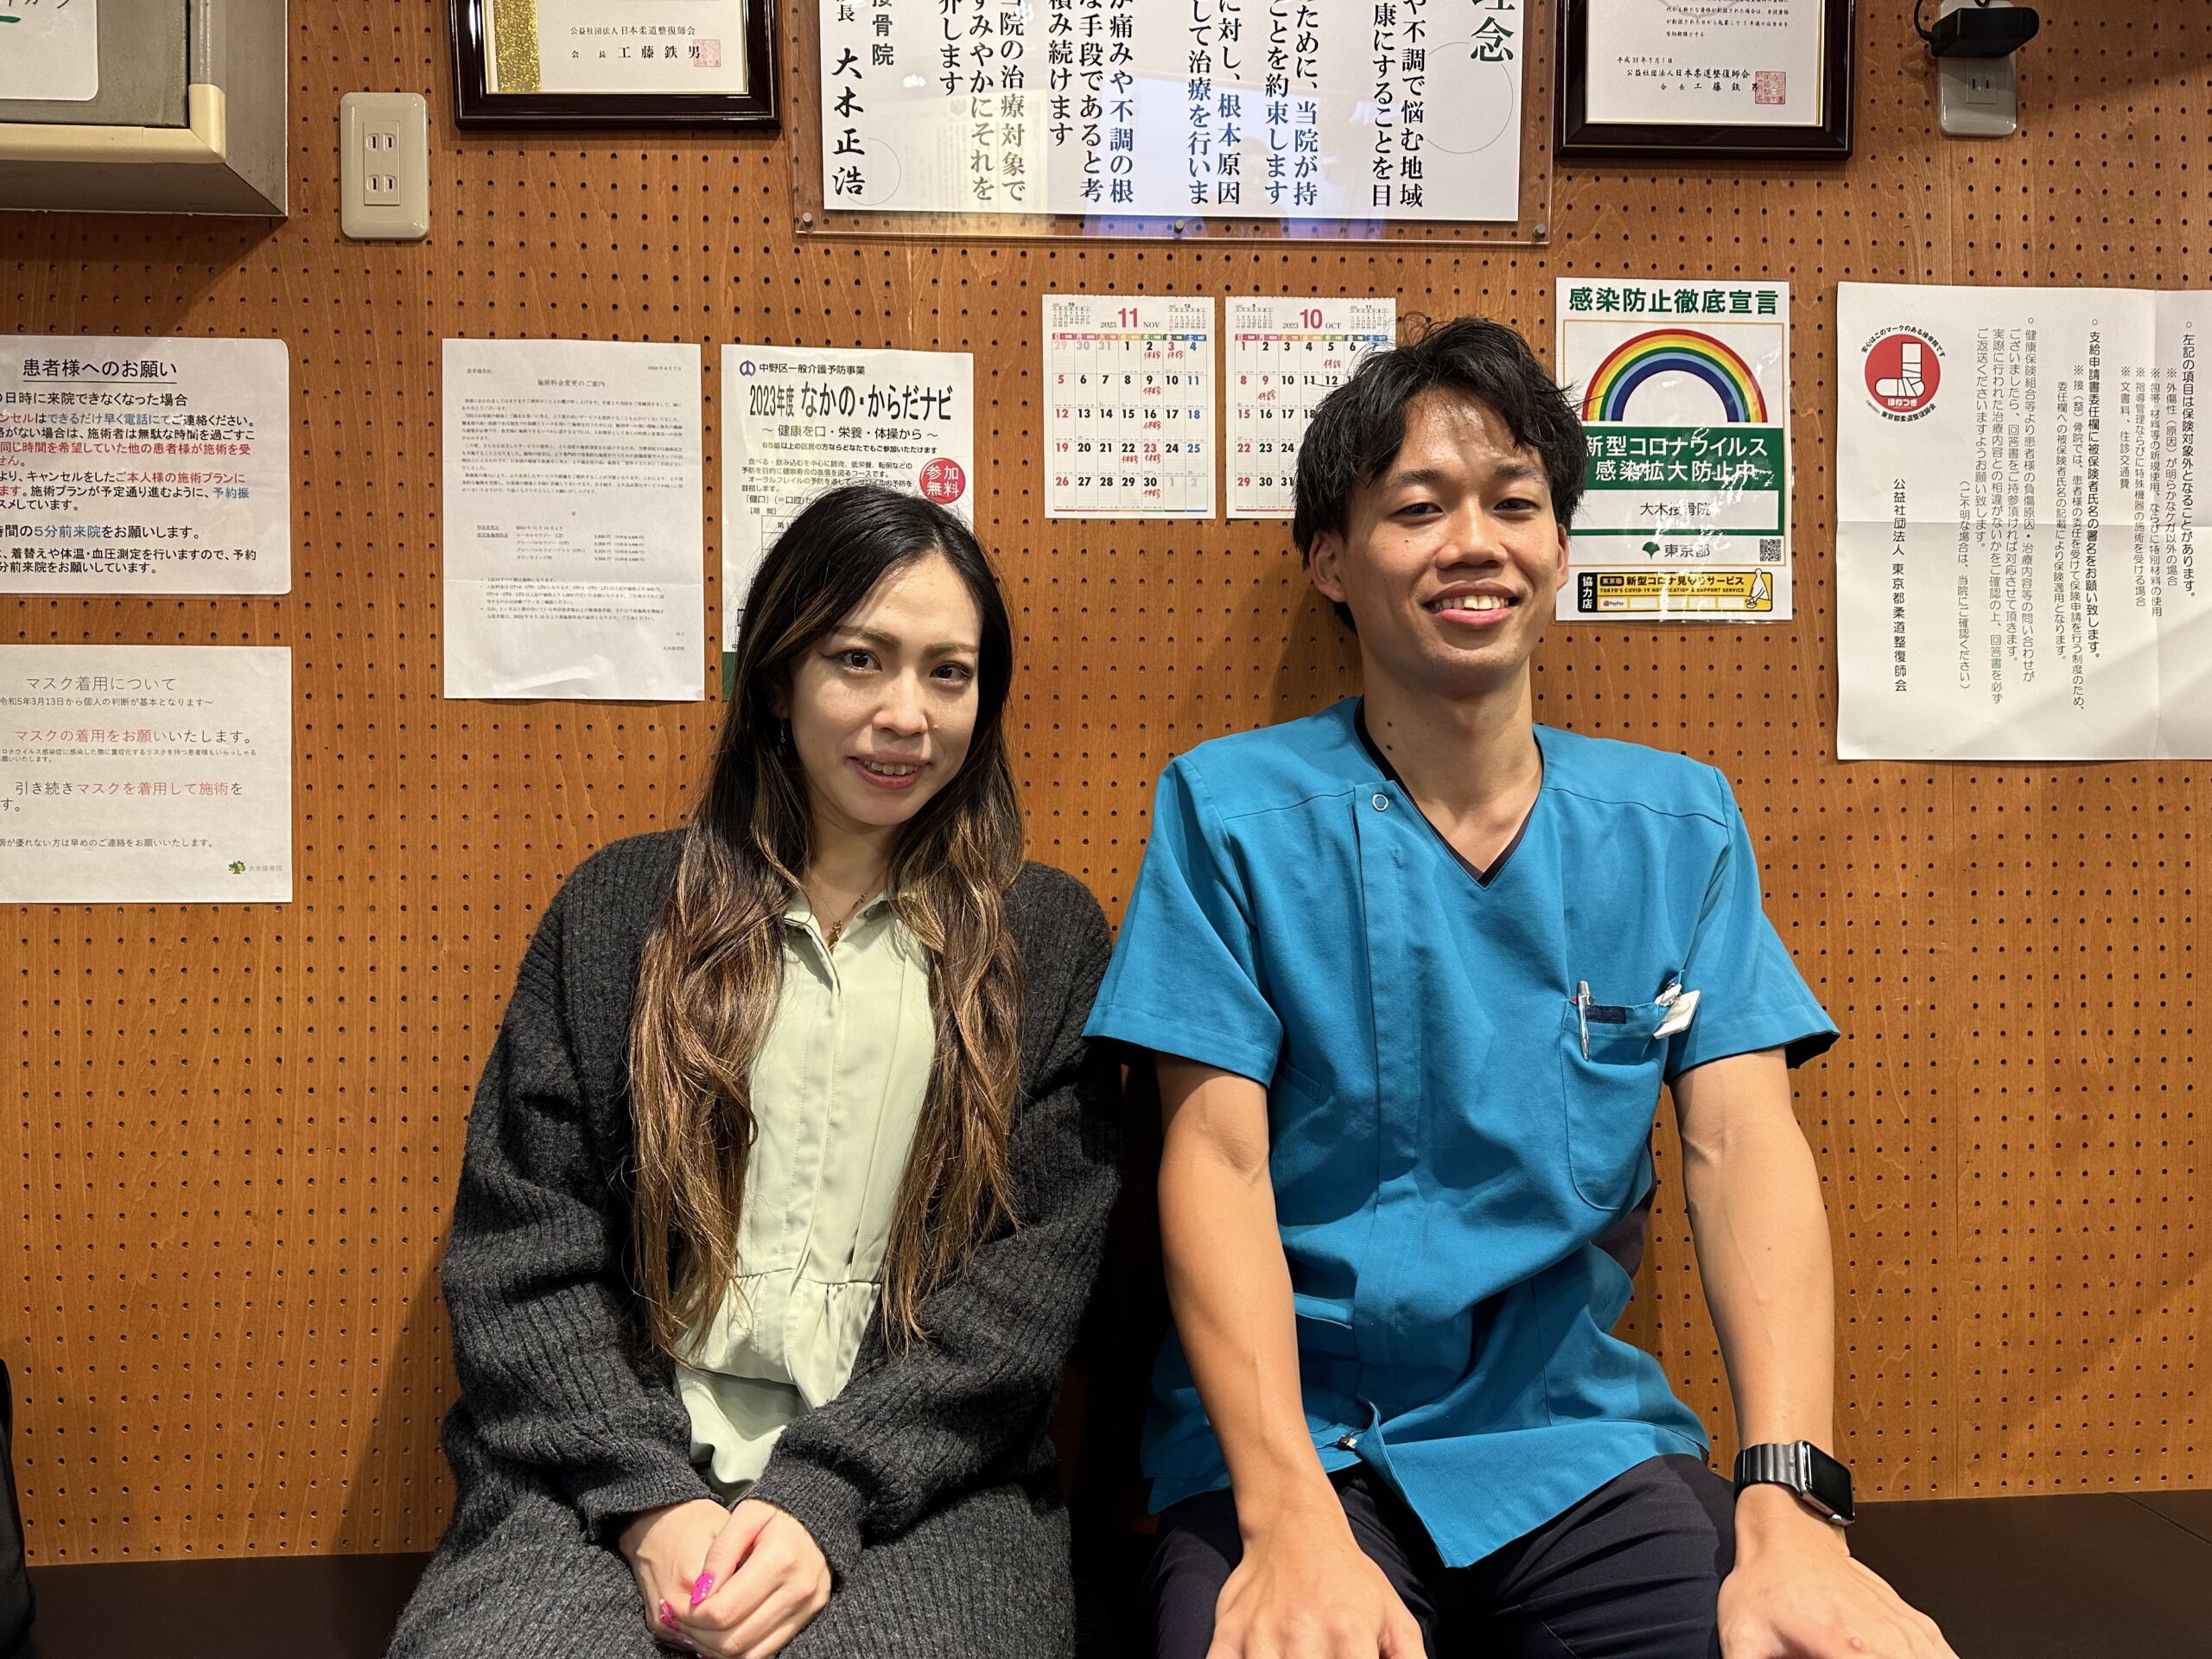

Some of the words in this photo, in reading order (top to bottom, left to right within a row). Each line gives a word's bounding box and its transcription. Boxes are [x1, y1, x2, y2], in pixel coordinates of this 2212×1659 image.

[570, 26, 696, 35] 公益社団法人日本柔道整復師会
[872, 0, 894, 66] 骨院
[618, 46, 701, 60] 工藤鉄男
[1626, 67, 1751, 79] 公益社団法人日本柔道整復師会
[1694, 81, 1759, 92] 工藤鉄男
[1000, 0, 1026, 202] 院の治療対象で
[1188, 0, 1212, 205] して治療を行いま
[1264, 0, 1289, 206] ことを約束します
[1294, 0, 1319, 207] ために、当院が持
[1372, 2, 1397, 207] 康にすることを目
[831, 48, 866, 197] 大木正浩
[1568, 287, 1778, 315] 感染防止徹底宣言
[1118, 308, 1137, 327] 11
[1300, 309, 1322, 328] 10
[1125, 341, 1129, 350] 1
[1147, 341, 1153, 350] 2
[1168, 341, 1174, 351] 3
[1190, 342, 1196, 351] 4
[1242, 341, 1245, 351] 1
[1262, 341, 1268, 351] 2
[1284, 342, 1290, 351] 3
[1306, 342, 1313, 351] 4
[1328, 342, 1333, 351] 5
[1350, 342, 1356, 351] 6
[22, 359, 177, 378] 患者様へのお願い
[759, 363, 866, 375] 中野区一般介護予防事業
[537, 379, 606, 388] 施術料金変更のご案内
[1058, 375, 1064, 384] 5
[1080, 375, 1086, 384] 6
[1103, 375, 1109, 384] 7
[1125, 375, 1130, 385] 8
[1147, 376, 1153, 385] 9
[1166, 376, 1178, 385] 10
[1188, 376, 1198, 385] 11
[1241, 375, 1247, 385] 8
[1262, 376, 1268, 385] 9
[1282, 376, 1294, 385] 10
[1304, 376, 1316, 385] 11
[1325, 376, 1339, 386] 12
[0, 391, 188, 406] 日時に来院できなくなった場合
[749, 384, 795, 417] 2023年度
[800, 380, 954, 422] なかの・からだナビ
[1887, 397, 1917, 407] ほねつぎ
[1056, 409, 1068, 418] 12
[1078, 409, 1090, 418] 13
[1101, 409, 1113, 418] 14
[1122, 410, 1135, 418] 15
[1145, 410, 1156, 418] 16
[1166, 410, 1179, 418] 17
[1188, 410, 1200, 419] 18
[1238, 410, 1250, 418] 15
[1261, 410, 1272, 418] 16
[1282, 410, 1294, 418] 17
[1975, 328, 1988, 548] ご返送くださいますようお願い致します。
[1, 442, 251, 456] 同じ時間を希望していた他の患者様が施術を受
[762, 442, 938, 454] 65歳以上の区民の方ならどなたでもご参加いただけます
[1057, 442, 1068, 452] 19
[1077, 443, 1090, 452] 20
[1100, 443, 1111, 452] 21
[1122, 443, 1135, 452] 22
[1144, 443, 1156, 453] 23
[1166, 443, 1179, 453] 24
[1188, 444, 1200, 453] 25
[1237, 443, 1250, 452] 22
[1260, 443, 1272, 452] 23
[1281, 443, 1294, 452] 24
[1587, 435, 1768, 457] 新型コロナウイルス
[926, 465, 959, 480] 参加
[1595, 461, 1756, 482] 感染拡大防止中
[2181, 334, 2196, 597] 左記の項目は保険対象外となることがあります。
[926, 480, 960, 497] 無料
[1056, 477, 1069, 486] 26
[1078, 477, 1091, 486] 27
[1100, 477, 1113, 486] 28
[1122, 477, 1135, 486] 29
[1144, 477, 1157, 486] 30
[1237, 477, 1250, 486] 29
[1259, 477, 1272, 486] 30
[1281, 477, 1294, 486] 31
[0, 485, 250, 499] ます。施術プランが予定通り進むように、予約振
[2005, 328, 2020, 662] ございましたら、回答書をご持参頂ければ対応させて頂きます。
[2086, 331, 2101, 658] 支給申請書委任欄に被保険者氏名の署名をお願い致します。
[1892, 478, 1906, 556] 公益社団法人
[1990, 328, 2005, 704] 実際に行われた治療内容との相違がないかをご確認の上、回答書を必ず
[0, 524, 200, 539] 間の5分前来院をお願いします。
[0, 547, 257, 562] 、着替えや体温・血圧測定を行いますので、予約
[1664, 543, 1710, 557] 東京都
[1582, 576, 1593, 609] 協力店
[1892, 563, 1907, 692] 東京都柔道整復師会
[26, 676, 176, 692] マスク着用について
[15, 728, 251, 744] マスクの着用をお願いいたします。
[0, 747, 257, 757] ロナウイルス感染症に感染した際に重症化するリスクを持つ患者様もいらっしゃる
[16, 780, 242, 796] 引き続きマスクを着用して施術を
[1, 798, 21, 812] す。
